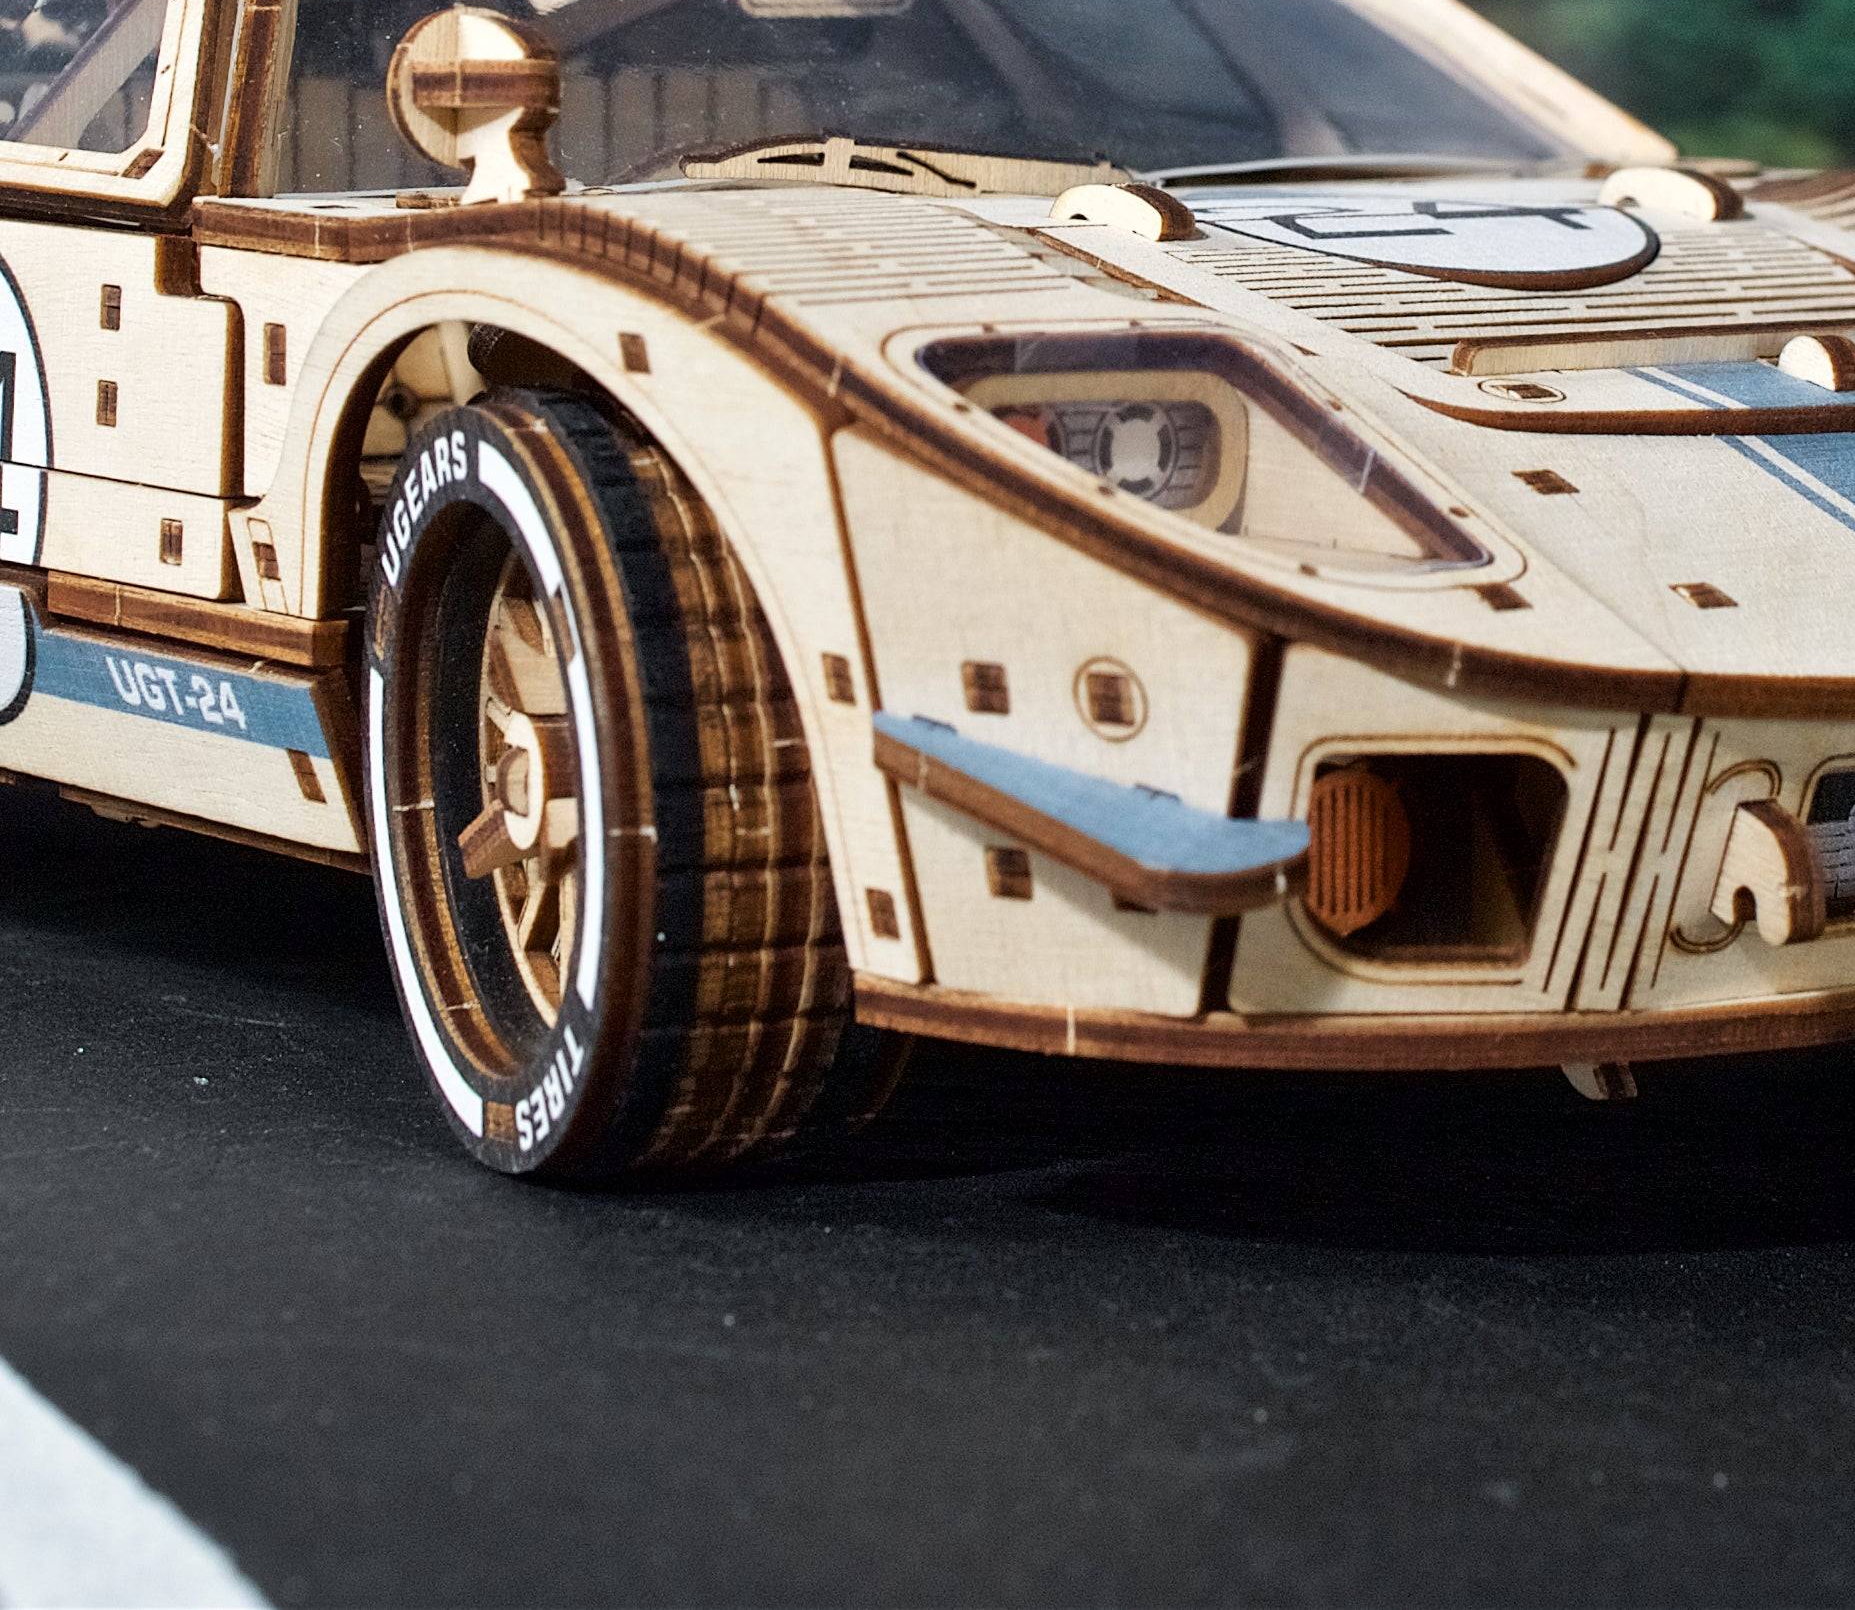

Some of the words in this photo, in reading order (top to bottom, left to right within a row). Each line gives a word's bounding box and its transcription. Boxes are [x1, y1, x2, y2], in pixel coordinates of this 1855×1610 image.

[381, 429, 468, 588] UGEARS
[105, 654, 247, 730] UGT-24
[515, 1024, 585, 1152] TIRES
